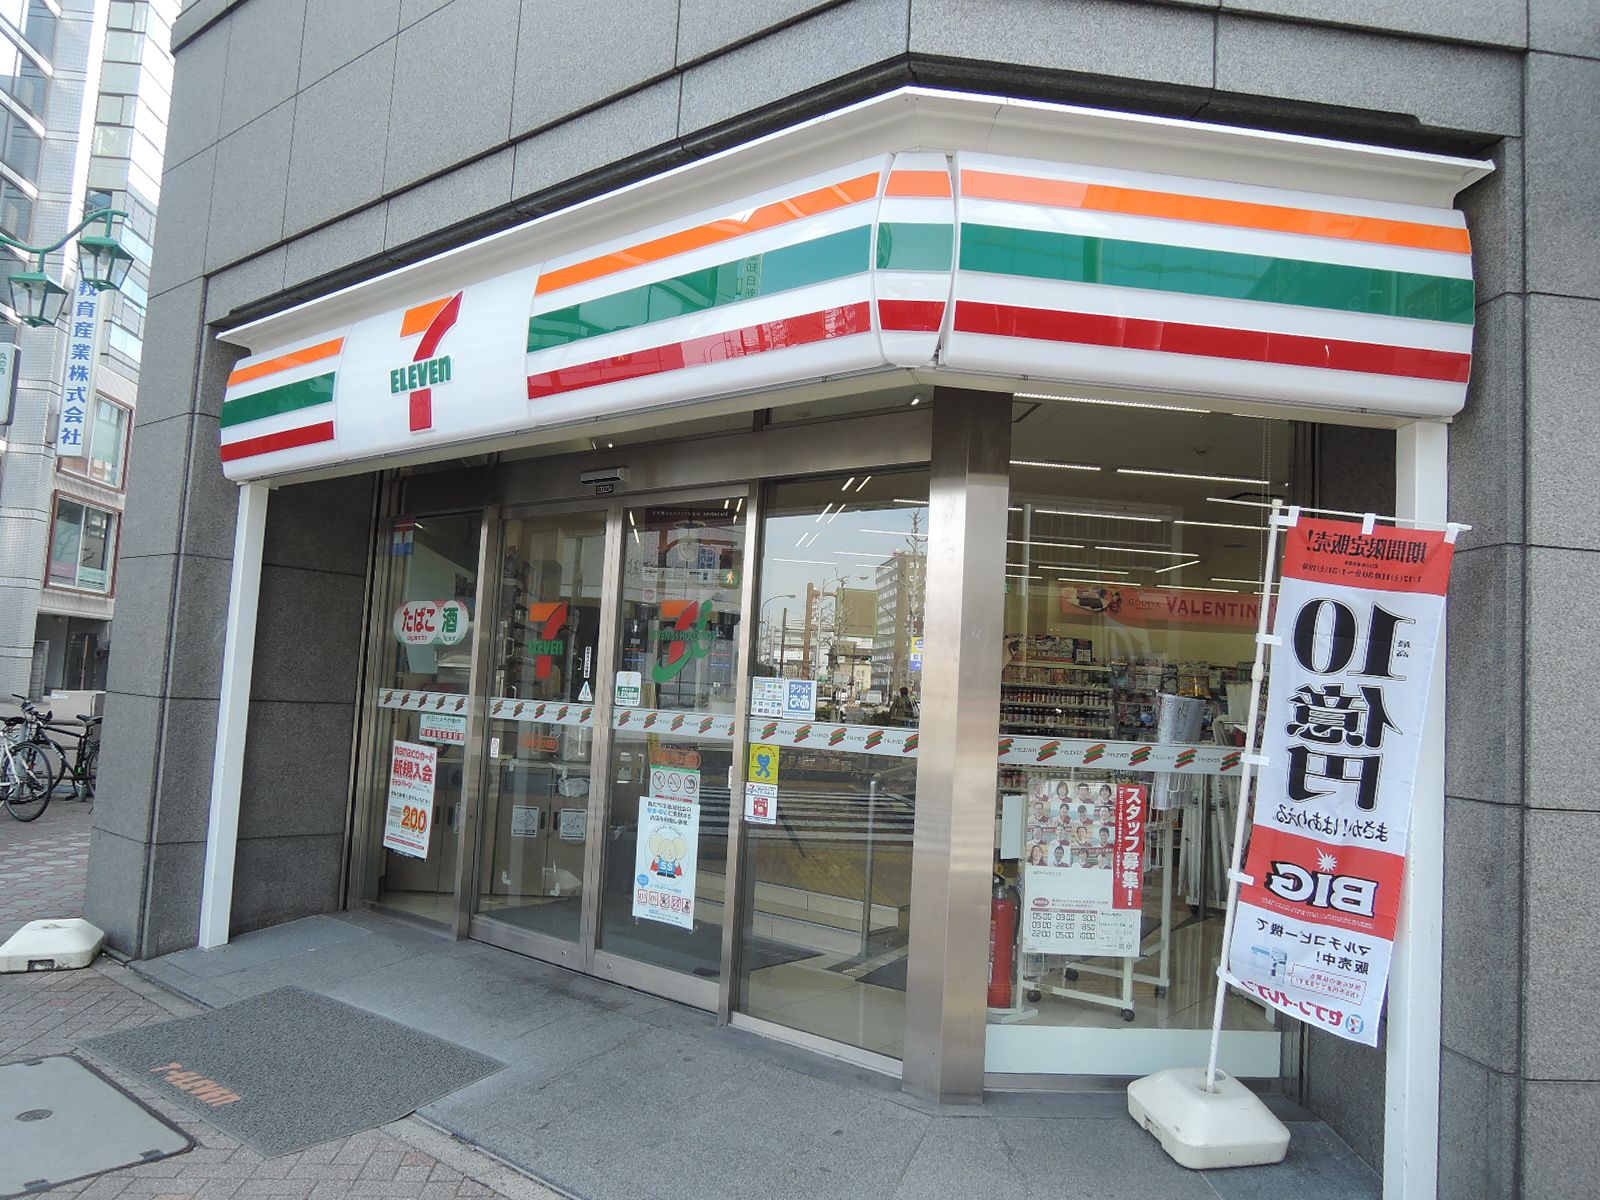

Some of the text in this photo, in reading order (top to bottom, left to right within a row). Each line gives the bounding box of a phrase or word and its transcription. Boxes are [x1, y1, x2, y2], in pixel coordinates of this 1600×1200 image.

[400, 290, 464, 432] 7
[1128, 598, 1160, 608] GODIVA
[1166, 595, 1258, 618] VALENTIN
[402, 607, 436, 632] たばこ
[442, 607, 459, 633] 酒
[790, 683, 811, 694] チケット
[789, 694, 810, 710] ぴあ
[393, 759, 433, 785] 新規入会
[401, 805, 428, 834] 200
[1121, 787, 1141, 906] スタッフ募集!
